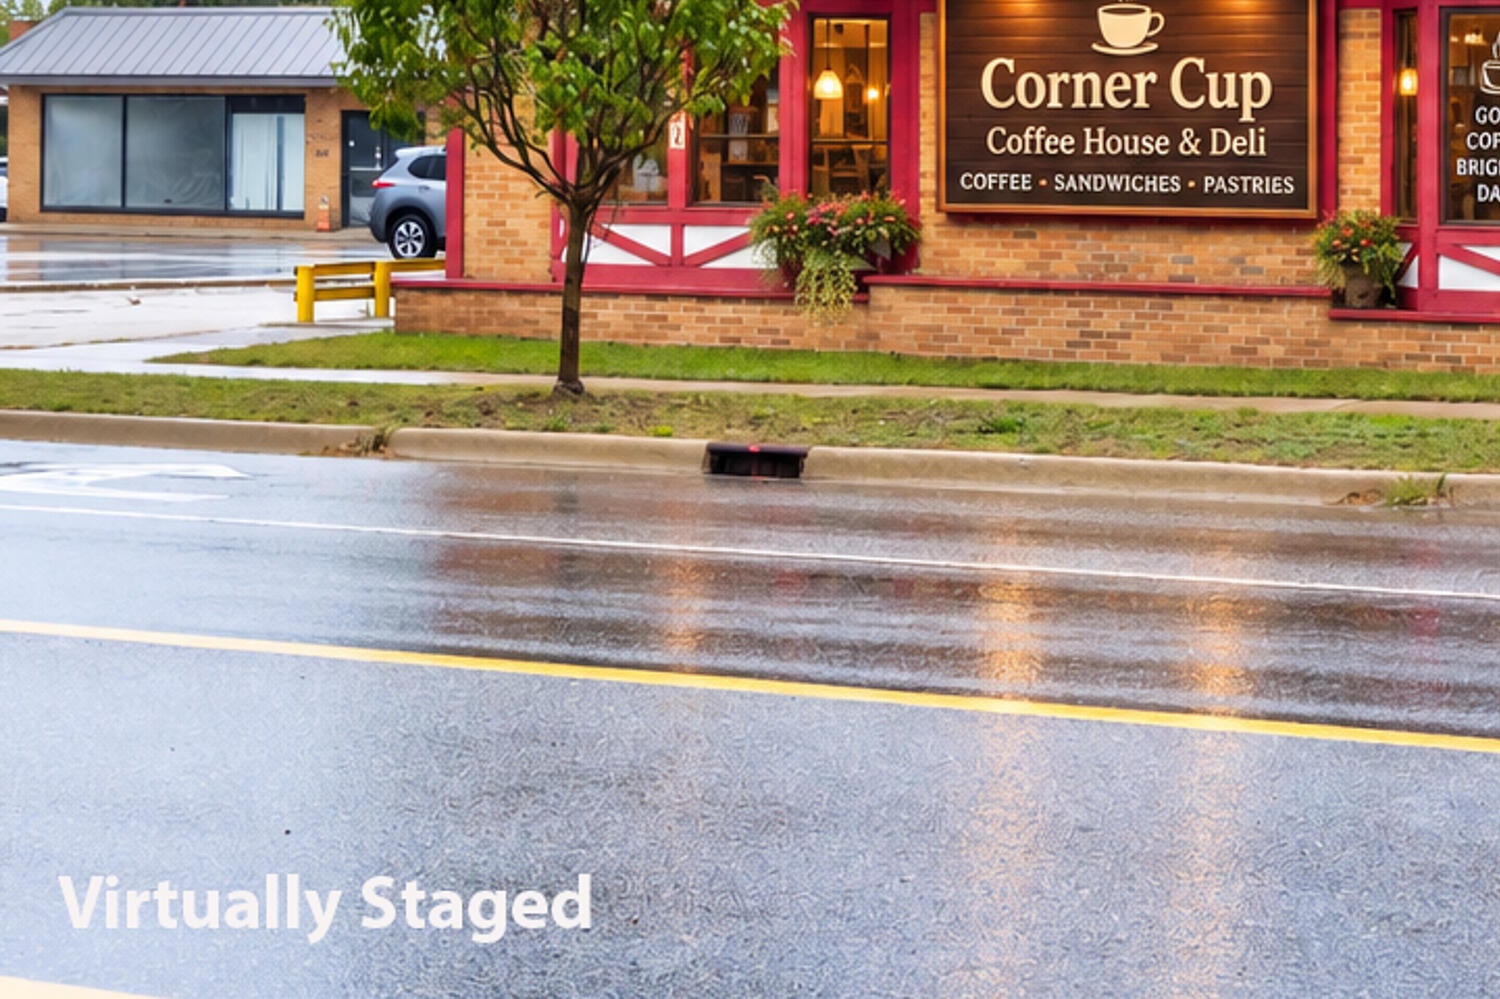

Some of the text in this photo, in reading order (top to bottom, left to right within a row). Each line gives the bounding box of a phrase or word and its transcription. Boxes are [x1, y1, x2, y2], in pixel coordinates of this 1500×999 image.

[981, 57, 1272, 122] Corner Cup
[986, 126, 1267, 158] Coffee House & Deli
[960, 173, 1295, 195] COFFEE SANDWICHES PASTRIES
